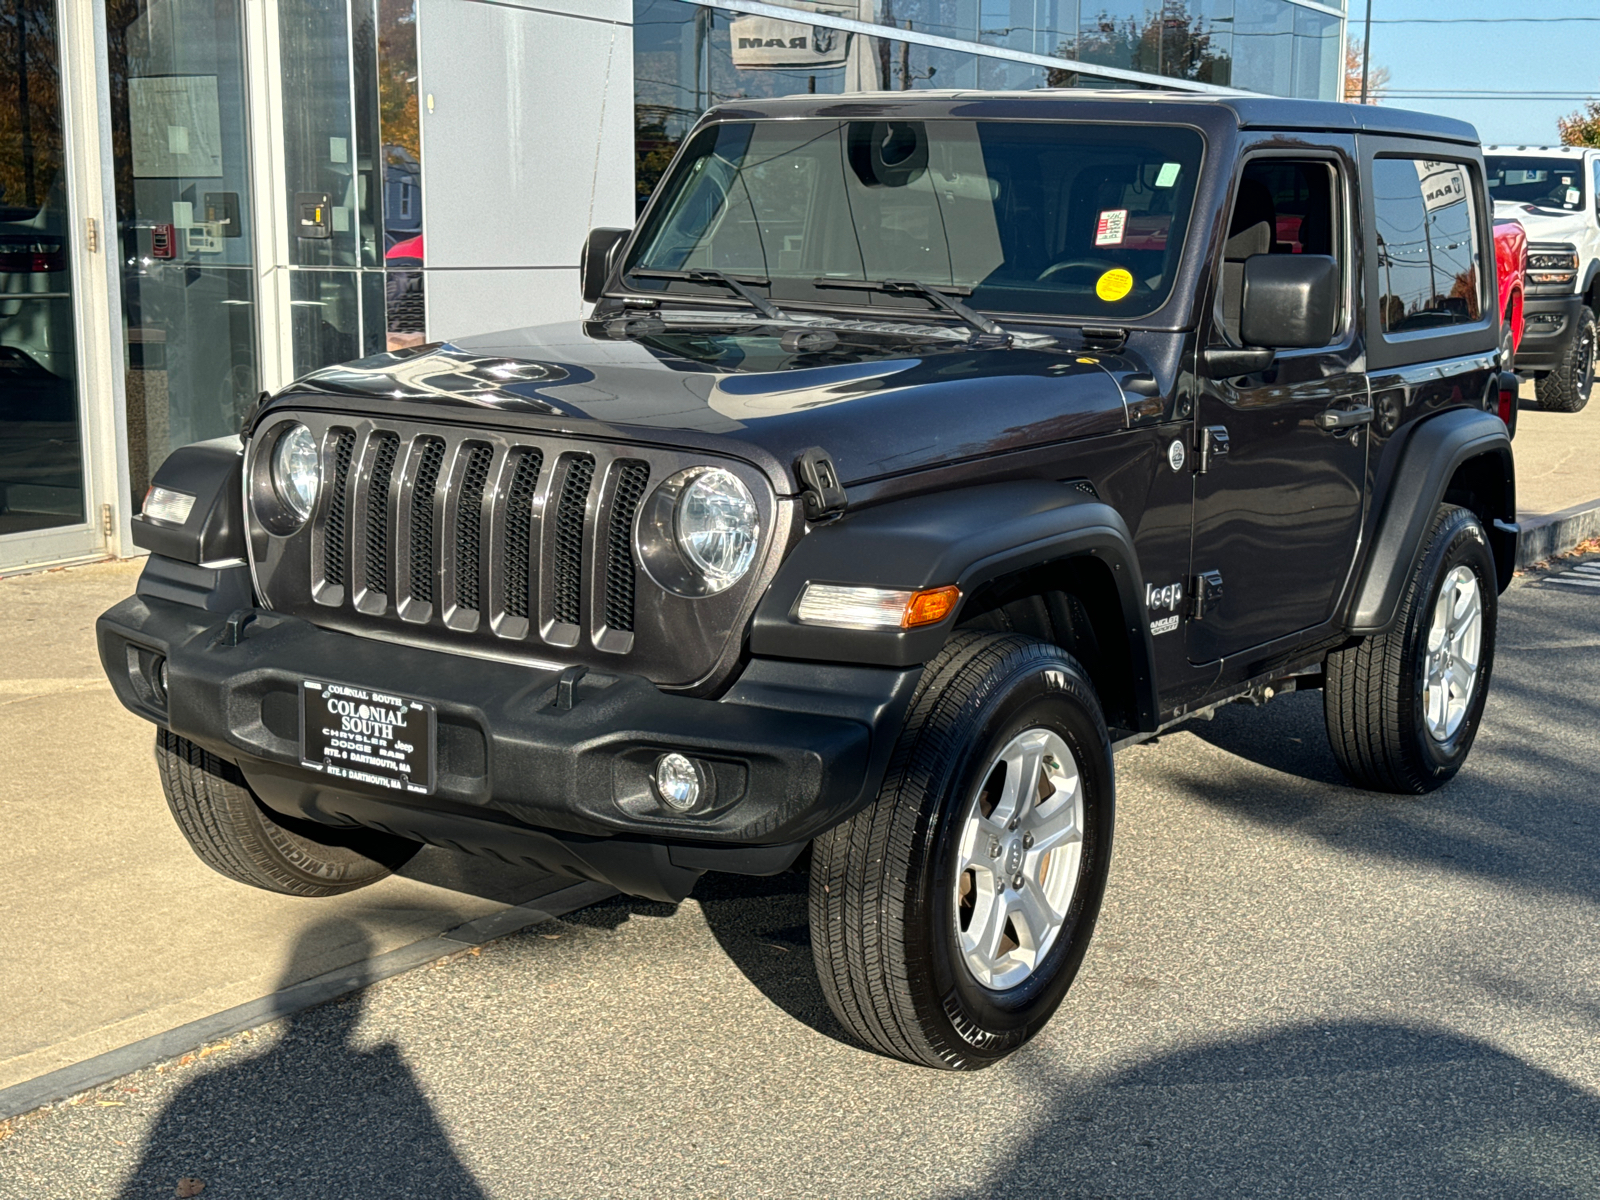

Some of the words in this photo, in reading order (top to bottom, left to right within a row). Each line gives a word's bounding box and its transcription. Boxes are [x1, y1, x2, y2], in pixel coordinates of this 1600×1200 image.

[1145, 582, 1183, 612] Jeep
[328, 684, 369, 700] COLONIAL
[372, 693, 403, 707] SOUTH
[327, 698, 408, 727] COLONIAL
[322, 728, 388, 747] CHRYSLER
[341, 716, 394, 740] SOUTH
[330, 738, 372, 754] DODGE
[394, 740, 414, 754] Jeep
[324, 747, 341, 758] RTE.
[341, 750, 348, 760] 6
[350, 752, 399, 772] DARTMOUTH,
[399, 762, 412, 773] MA
[348, 770, 391, 789] DARTMOUTH,
[391, 779, 402, 789] MA
[943, 995, 1003, 1051] MICHELIN
